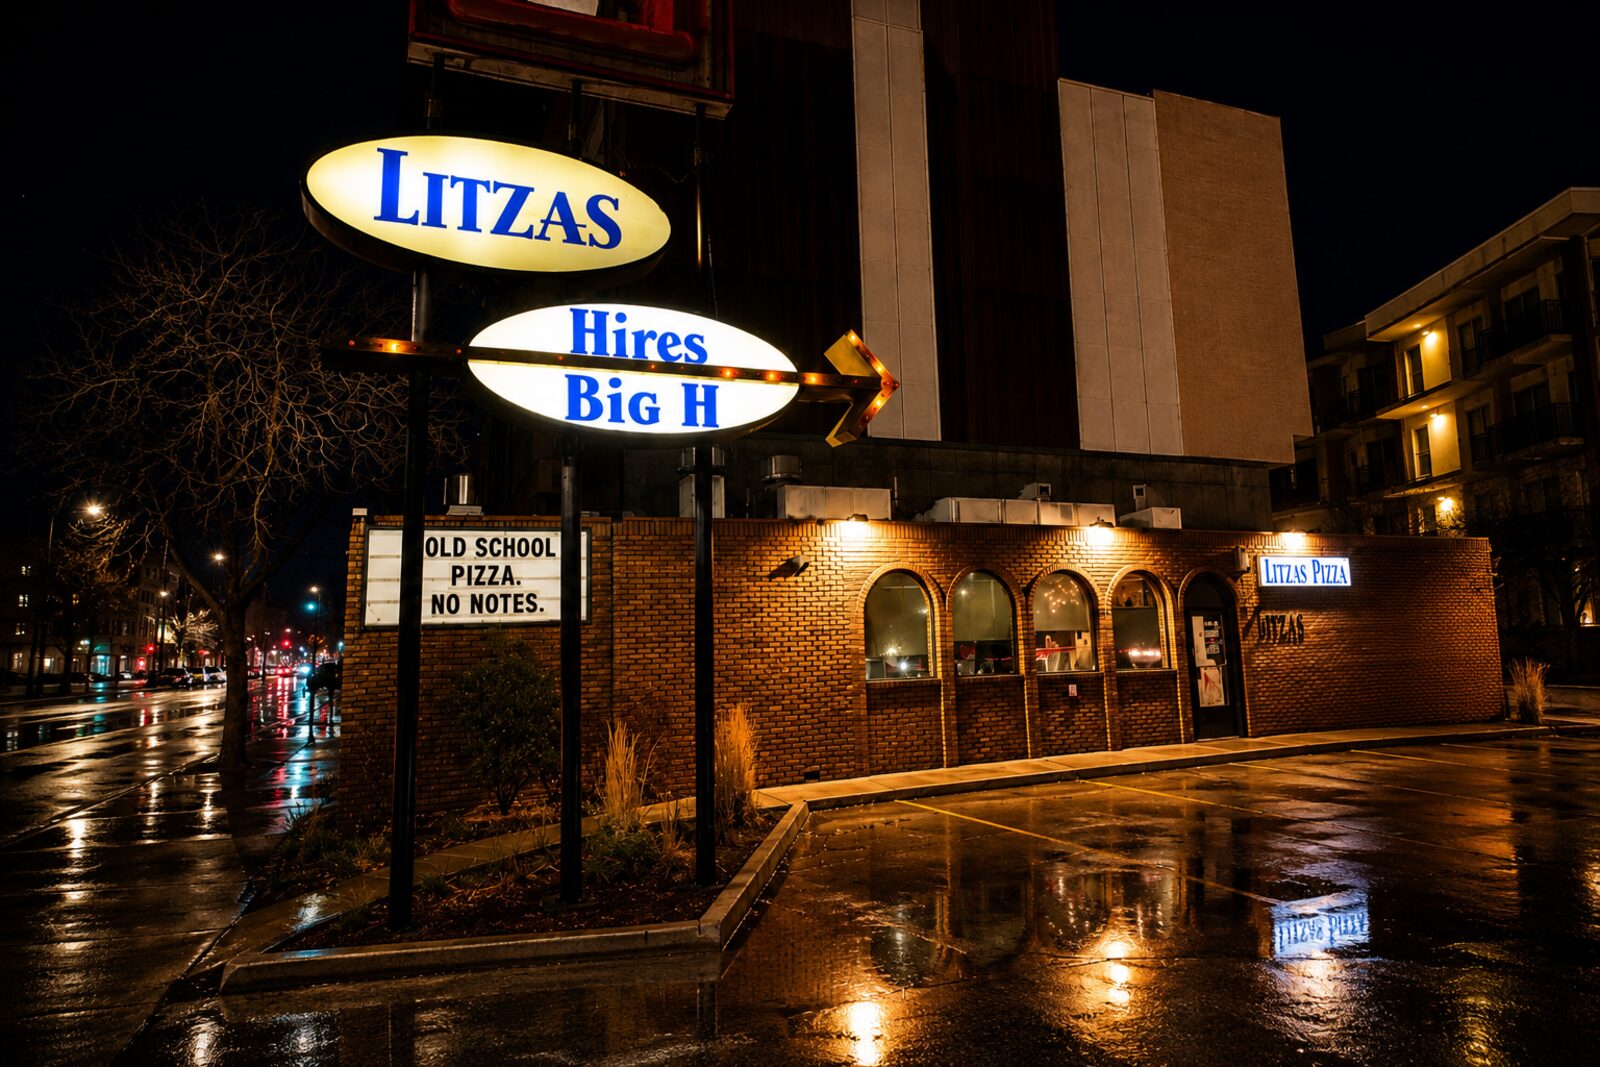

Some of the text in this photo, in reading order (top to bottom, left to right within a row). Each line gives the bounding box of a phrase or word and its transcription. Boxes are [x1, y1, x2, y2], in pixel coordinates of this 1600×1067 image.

[373, 147, 622, 249] LITZAS
[569, 308, 708, 365] Hires
[681, 382, 719, 429] H
[425, 537, 556, 558] OLD SCHOOL
[451, 565, 521, 586] PIZZA.
[1264, 558, 1348, 584] LITZAS PIZZA
[431, 593, 545, 614] NO NOTES.
